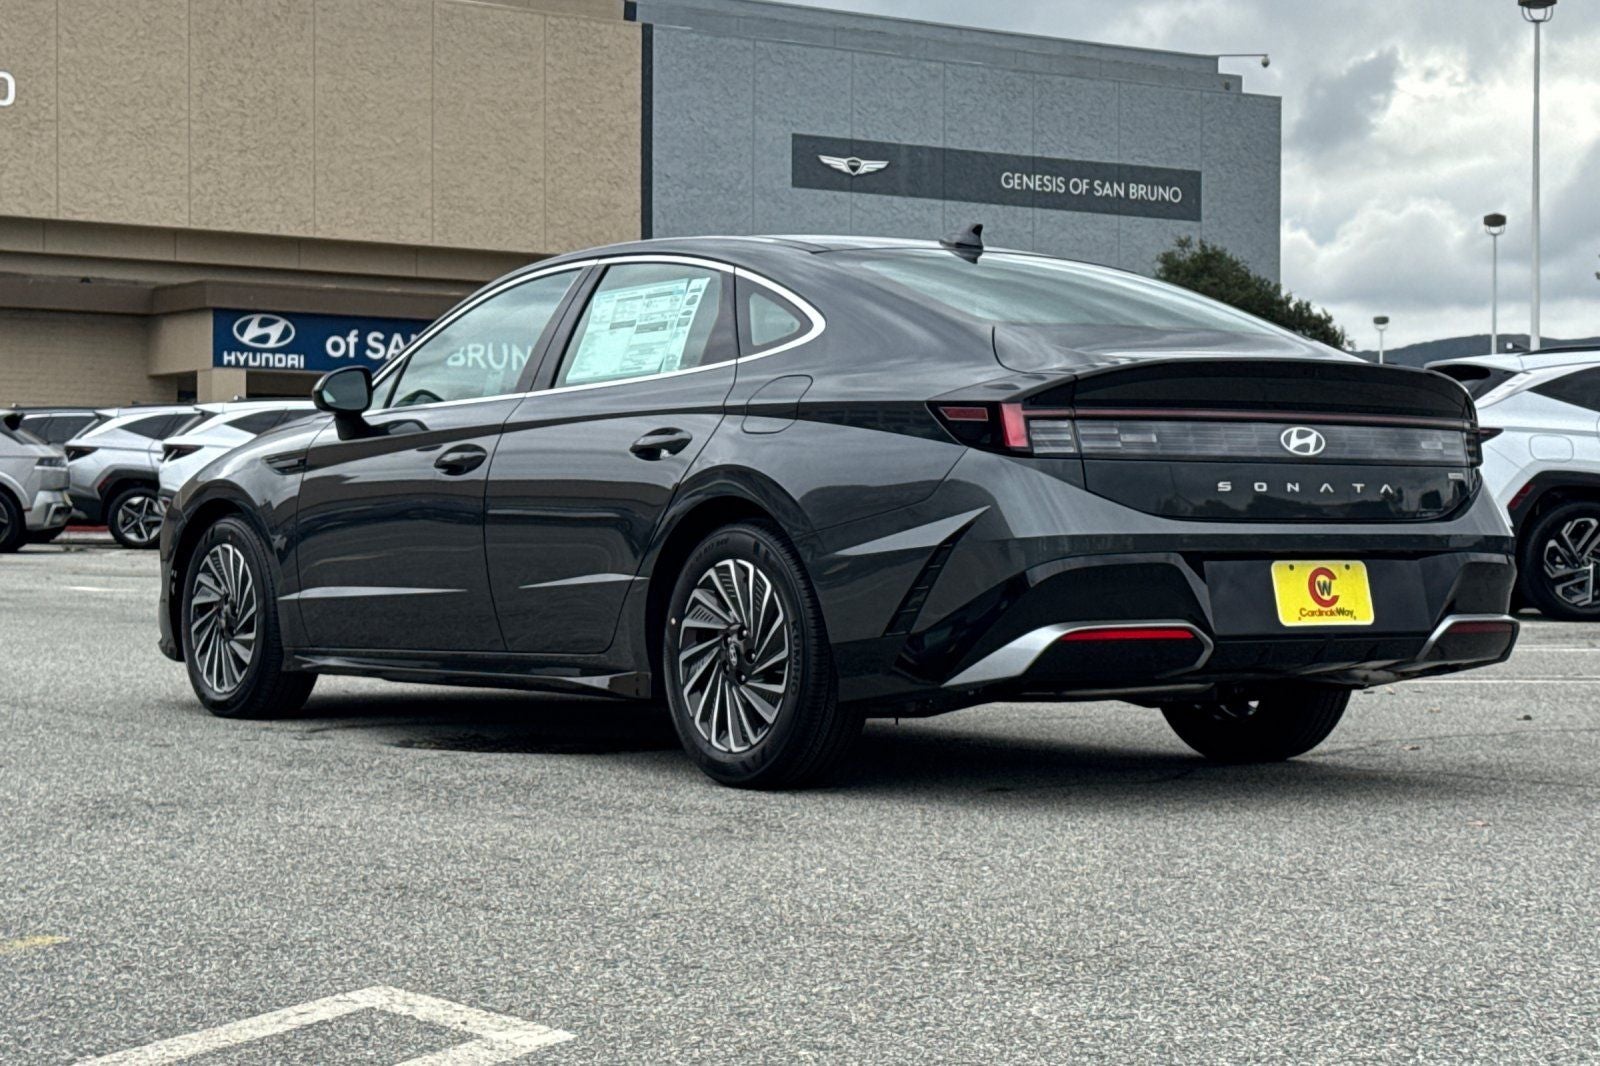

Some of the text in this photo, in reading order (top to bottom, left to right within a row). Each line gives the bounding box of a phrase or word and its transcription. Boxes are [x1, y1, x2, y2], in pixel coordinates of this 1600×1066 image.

[1001, 171, 1182, 203] GENESIS OF SAN BRUNO
[223, 350, 305, 369] HYUNDAI
[325, 329, 359, 358] of
[365, 331, 418, 360] SA
[1217, 481, 1393, 494] SONATA
